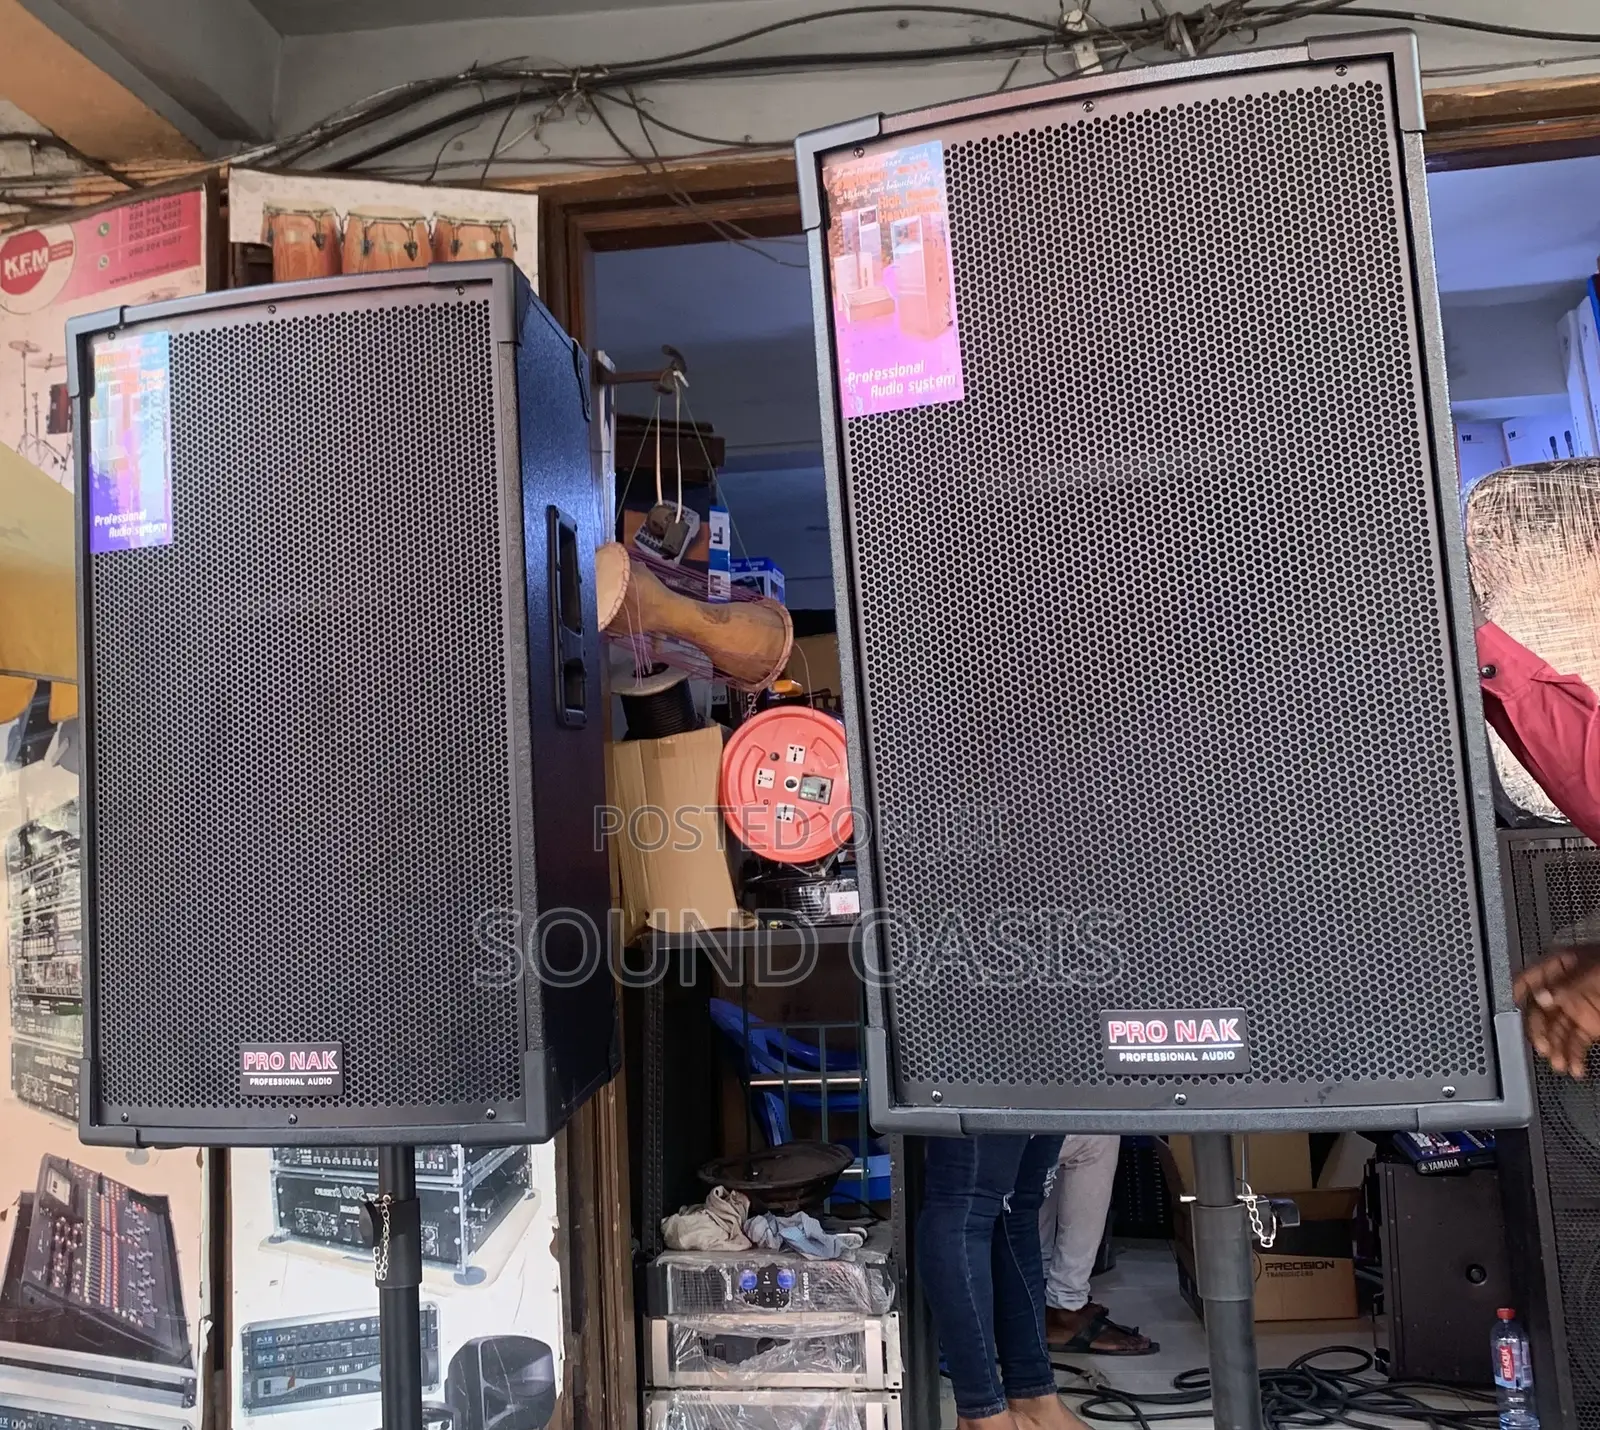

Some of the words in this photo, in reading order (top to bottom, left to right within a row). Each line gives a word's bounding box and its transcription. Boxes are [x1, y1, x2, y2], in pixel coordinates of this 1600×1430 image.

[4, 247, 48, 275] KFM
[847, 360, 925, 386] Professional
[871, 380, 903, 399] Audio
[908, 373, 956, 394] system
[94, 508, 147, 527] Professional
[108, 524, 132, 538] Audio
[135, 521, 168, 537] system
[1108, 1019, 1168, 1044] PRO
[1174, 1018, 1242, 1042] NAK
[243, 1051, 285, 1071] PRO
[289, 1050, 338, 1070] NAK
[1119, 1051, 1198, 1062] PROFESSIONAL
[1202, 1050, 1236, 1061] AUDIO
[249, 1077, 305, 1086] PROFESSIONAL
[307, 1077, 333, 1086] AUDIO
[1428, 1159, 1460, 1171] YAMAHA
[1265, 1260, 1335, 1271] PRECISION
